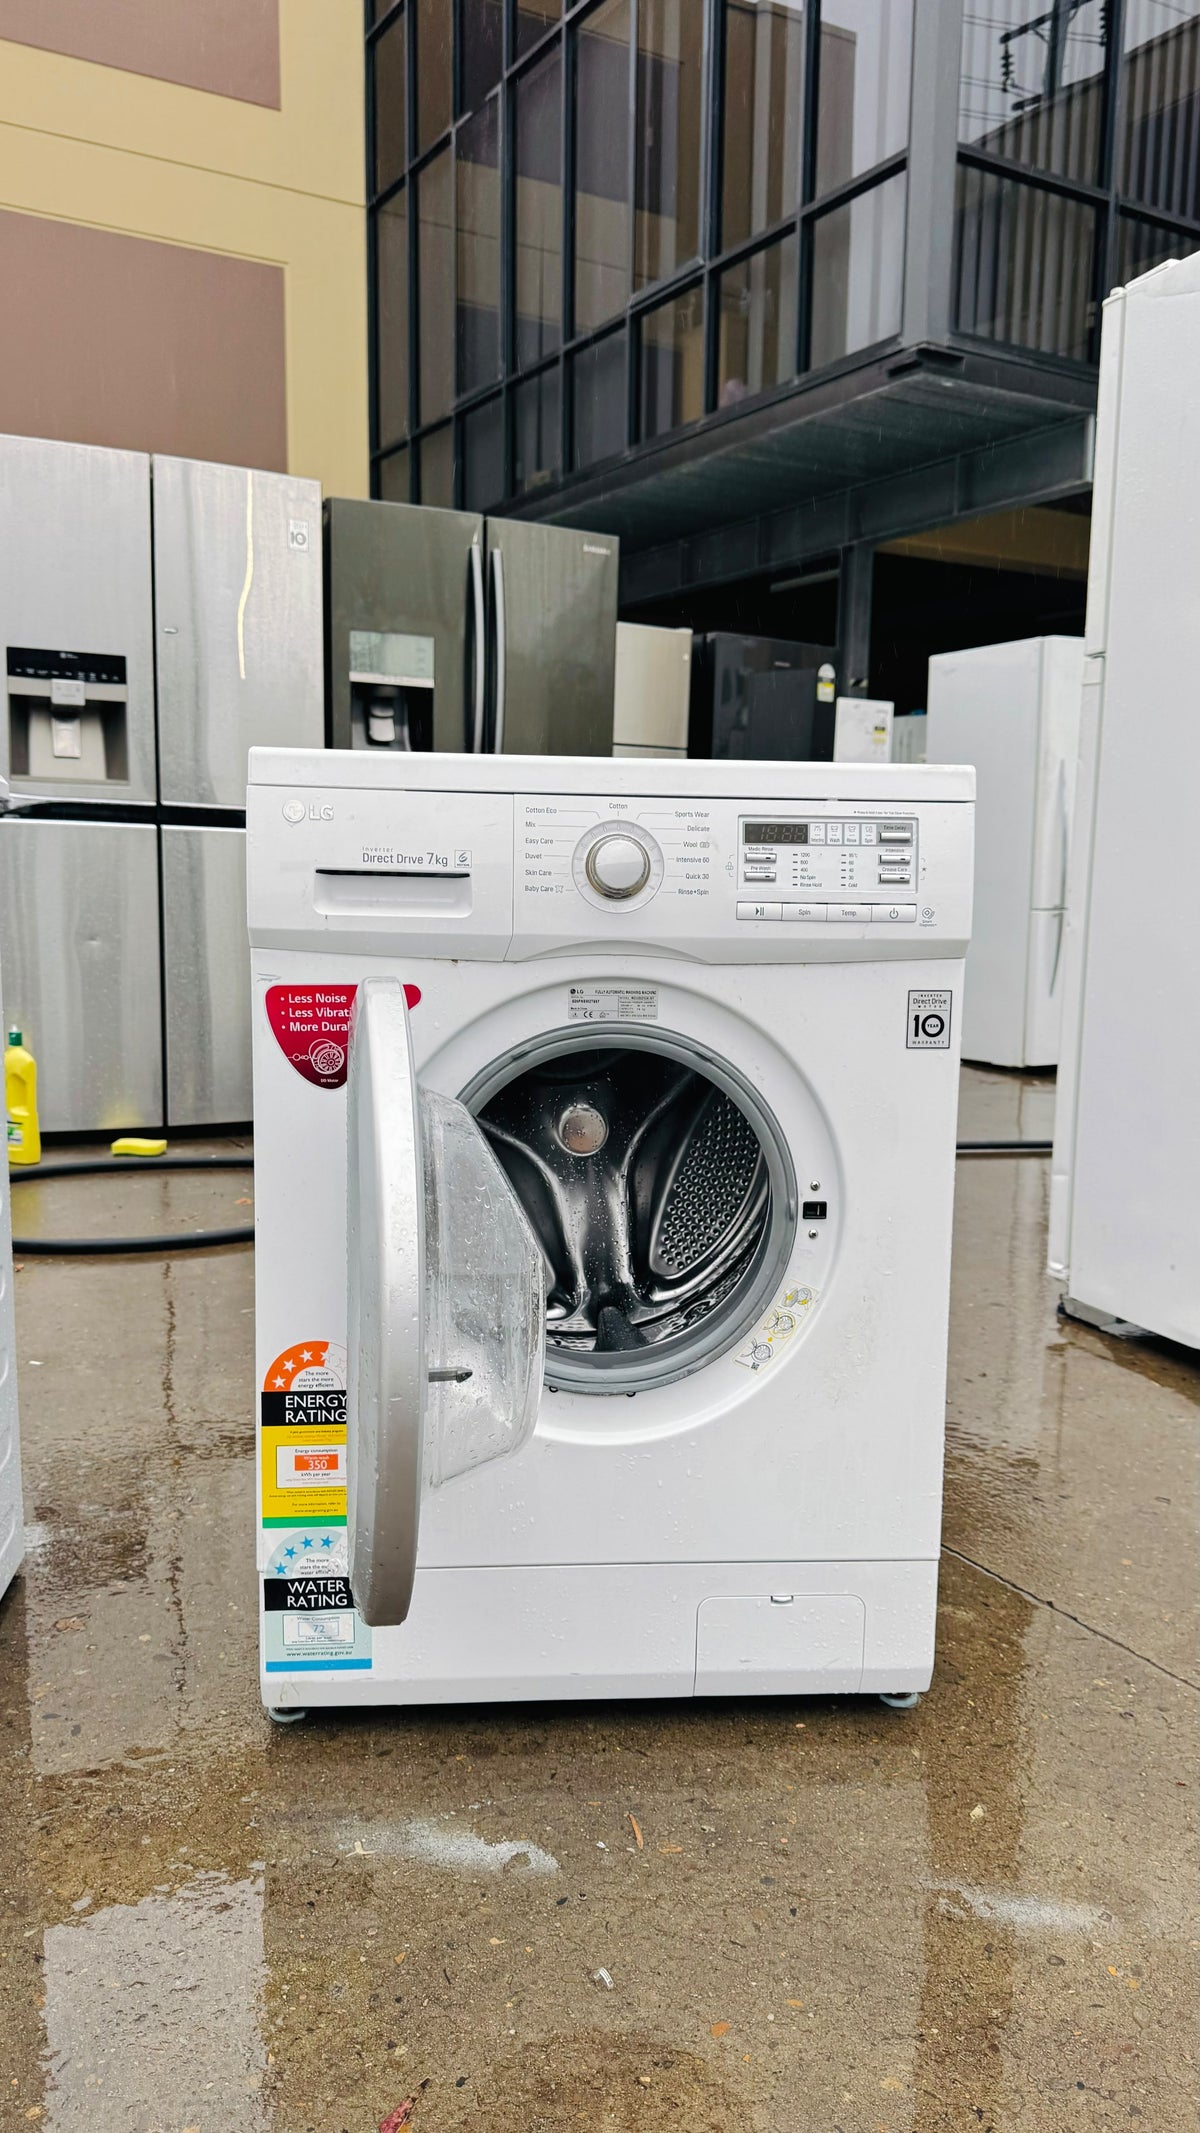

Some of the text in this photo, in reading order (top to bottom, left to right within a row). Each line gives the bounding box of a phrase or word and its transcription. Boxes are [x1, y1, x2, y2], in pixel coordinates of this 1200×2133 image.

[308, 804, 335, 821] LG
[362, 853, 394, 865] Direct
[396, 853, 424, 865] Drive
[525, 885, 540, 893] Baby
[289, 993, 347, 1004] Less Noise
[289, 1007, 313, 1018] Less
[290, 1022, 318, 1032] More
[913, 1014, 945, 1038] 10
[285, 1394, 347, 1408] ENERGY
[285, 1409, 347, 1423] RATING
[308, 1460, 327, 1470] 350
[288, 1580, 346, 1593] WATER
[287, 1594, 347, 1608] RATING
[313, 1624, 325, 1633] 72
